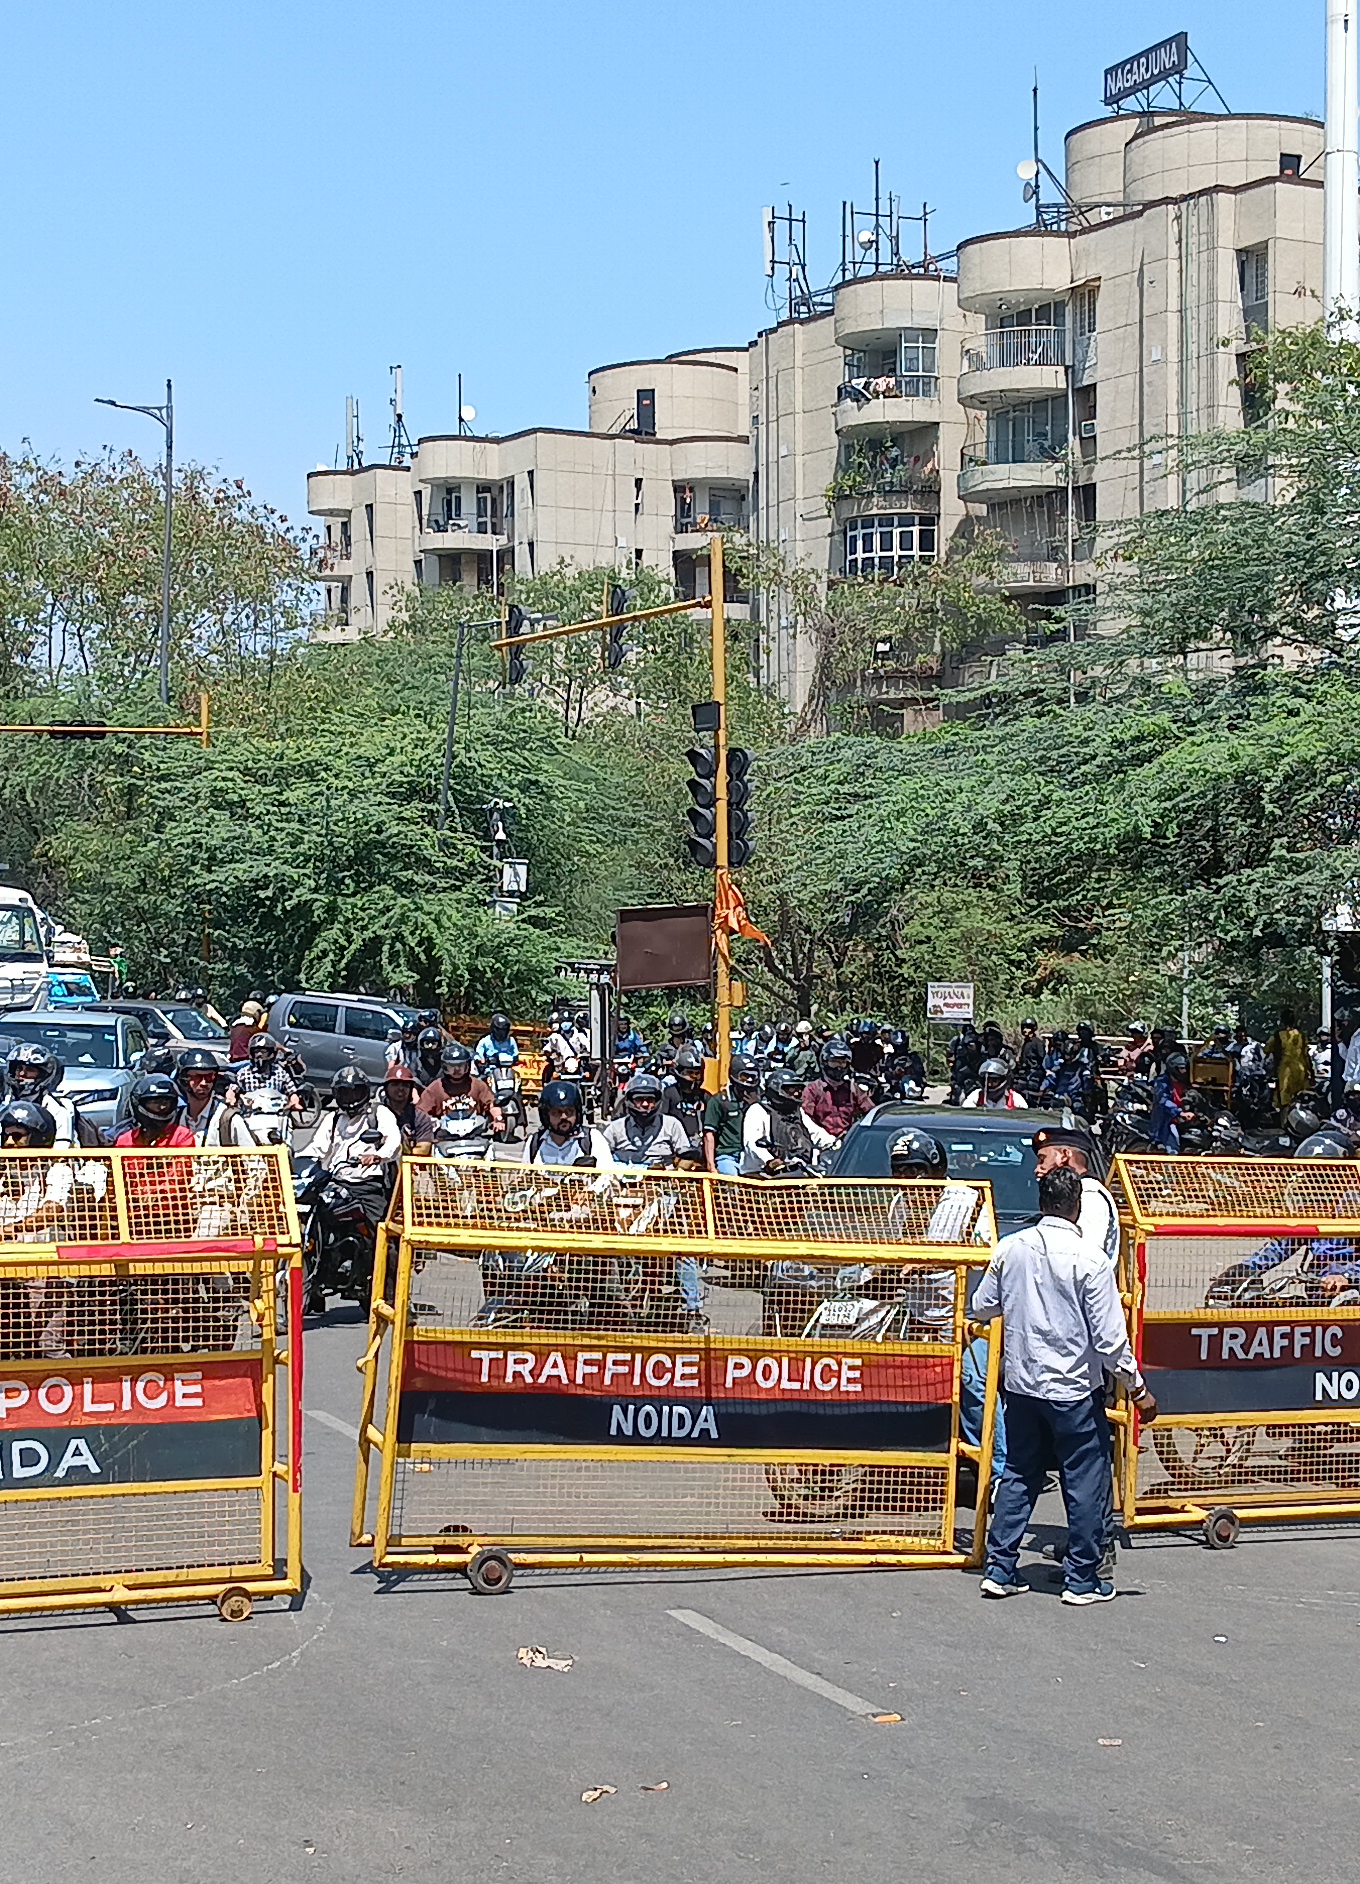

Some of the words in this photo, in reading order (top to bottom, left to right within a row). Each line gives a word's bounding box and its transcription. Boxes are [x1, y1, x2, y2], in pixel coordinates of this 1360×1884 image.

[1106, 42, 1179, 98] NAGARJUNA
[1191, 1325, 1343, 1361] TRAFFIC
[470, 1349, 700, 1388] TRAFFICE
[725, 1356, 862, 1391] POLICE
[609, 1405, 719, 1439] NOIDA
